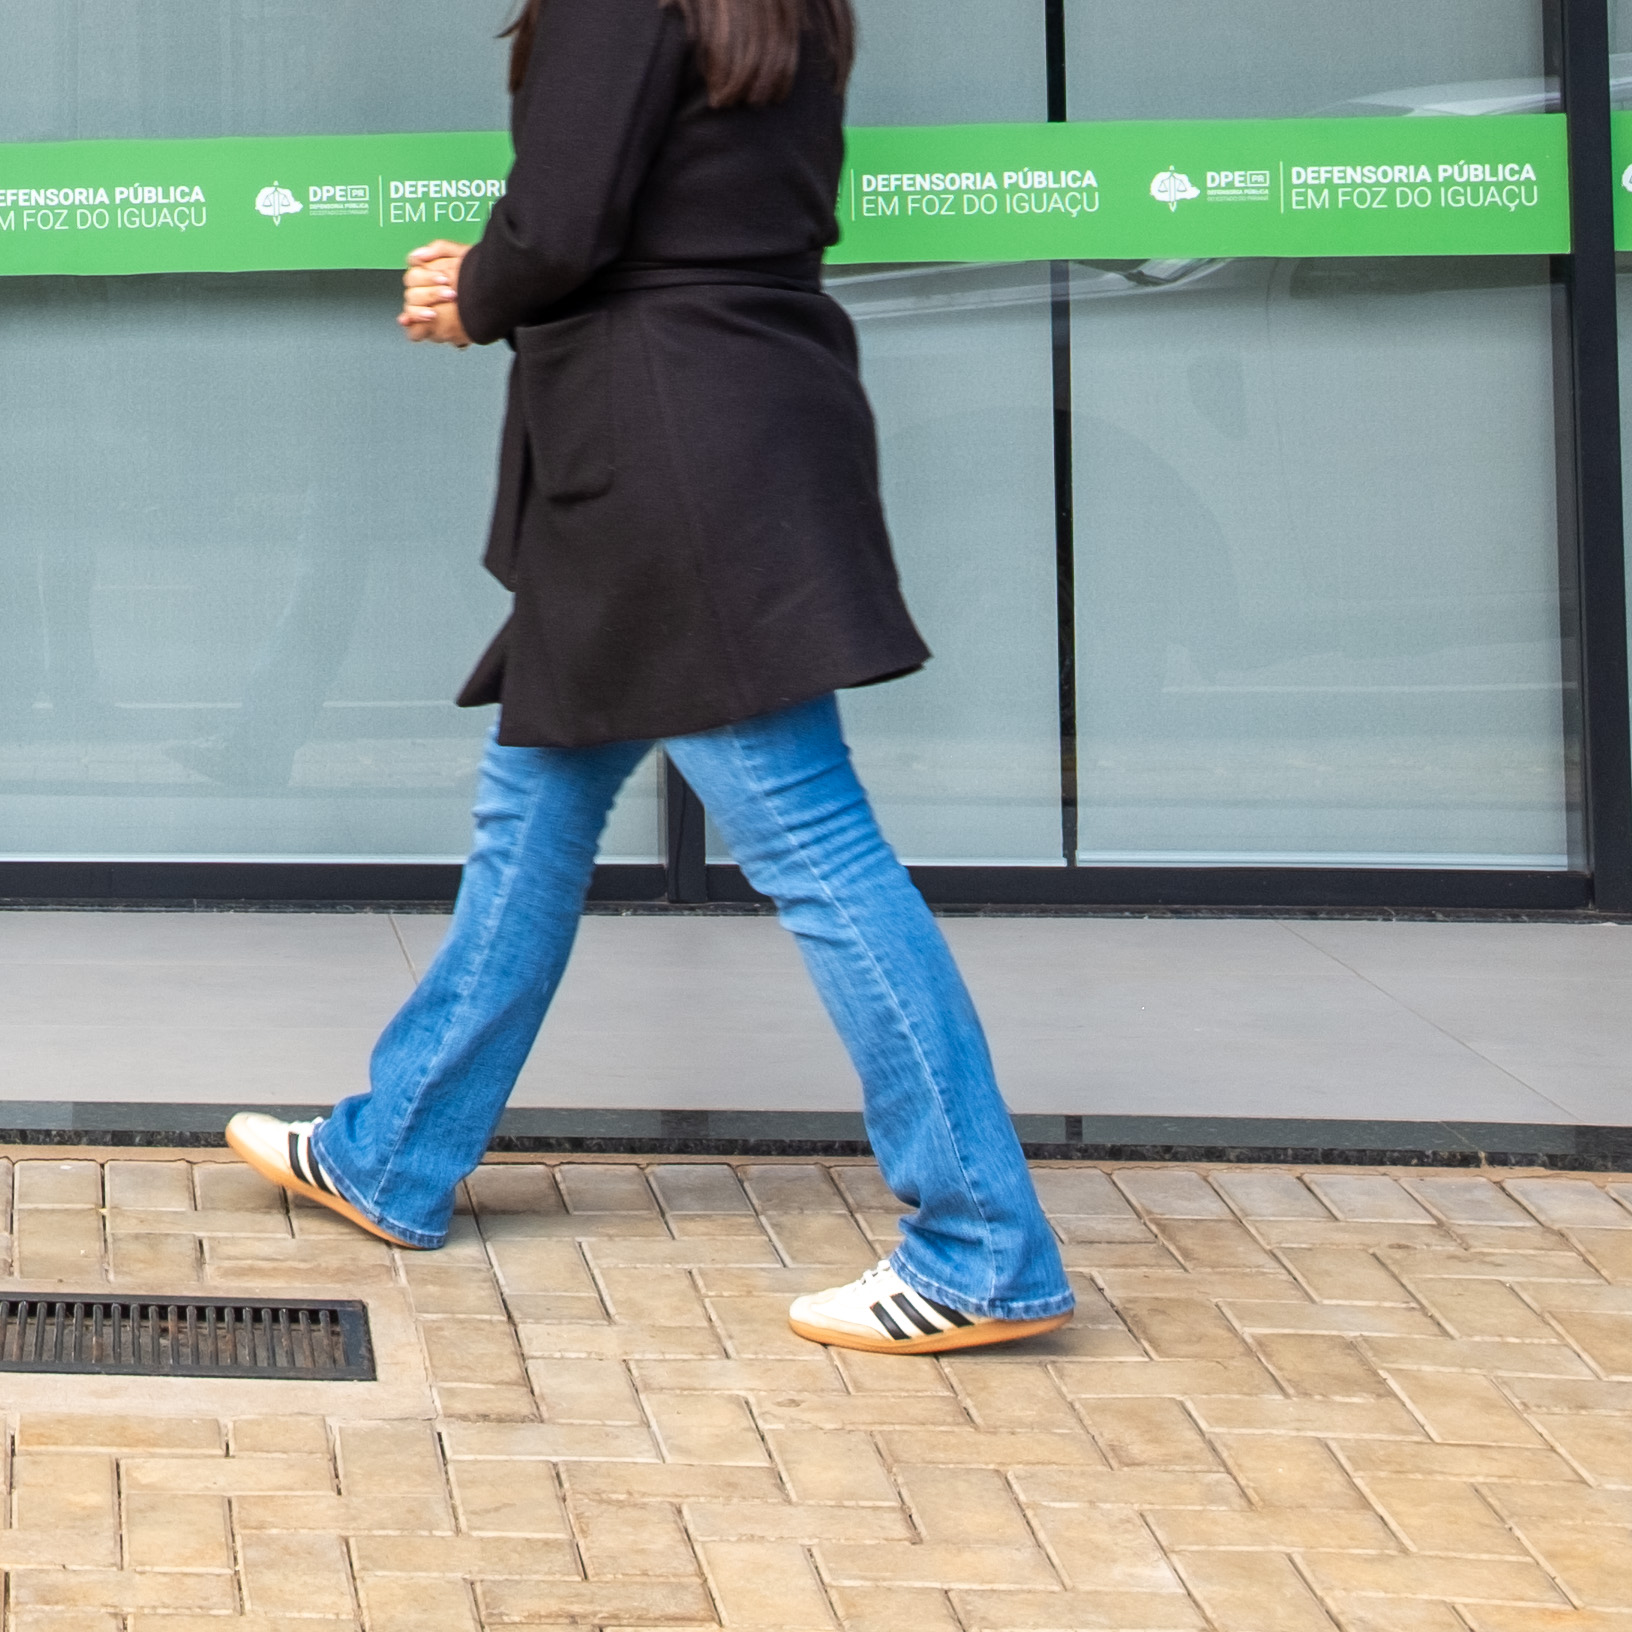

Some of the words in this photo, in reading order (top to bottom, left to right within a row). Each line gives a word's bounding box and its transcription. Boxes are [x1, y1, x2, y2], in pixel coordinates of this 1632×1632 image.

[862, 172, 998, 192] DEFENSORIA
[1003, 167, 1098, 189] PÚBLICA
[1206, 171, 1246, 188] DPE
[1291, 165, 1432, 185] DEFENSORIA
[1438, 160, 1537, 183] PÚBLICA
[114, 183, 206, 205] PÚBLICA
[309, 186, 347, 202] DPE
[389, 179, 506, 199] DEFENSORI
[1291, 188, 1329, 210] EM
[1338, 187, 1388, 209] FOZ
[1395, 186, 1432, 208] DO
[1440, 186, 1538, 212] IGUAÇU
[390, 202, 426, 223] EM
[434, 201, 481, 222] FOZ
[862, 196, 899, 217] EM
[907, 194, 955, 216] FOZ
[962, 194, 998, 215] DO
[1005, 192, 1099, 218] IGUAÇU
[23, 210, 69, 230] FOZ
[76, 209, 110, 229] DO
[117, 206, 207, 232] IGUAÇU
